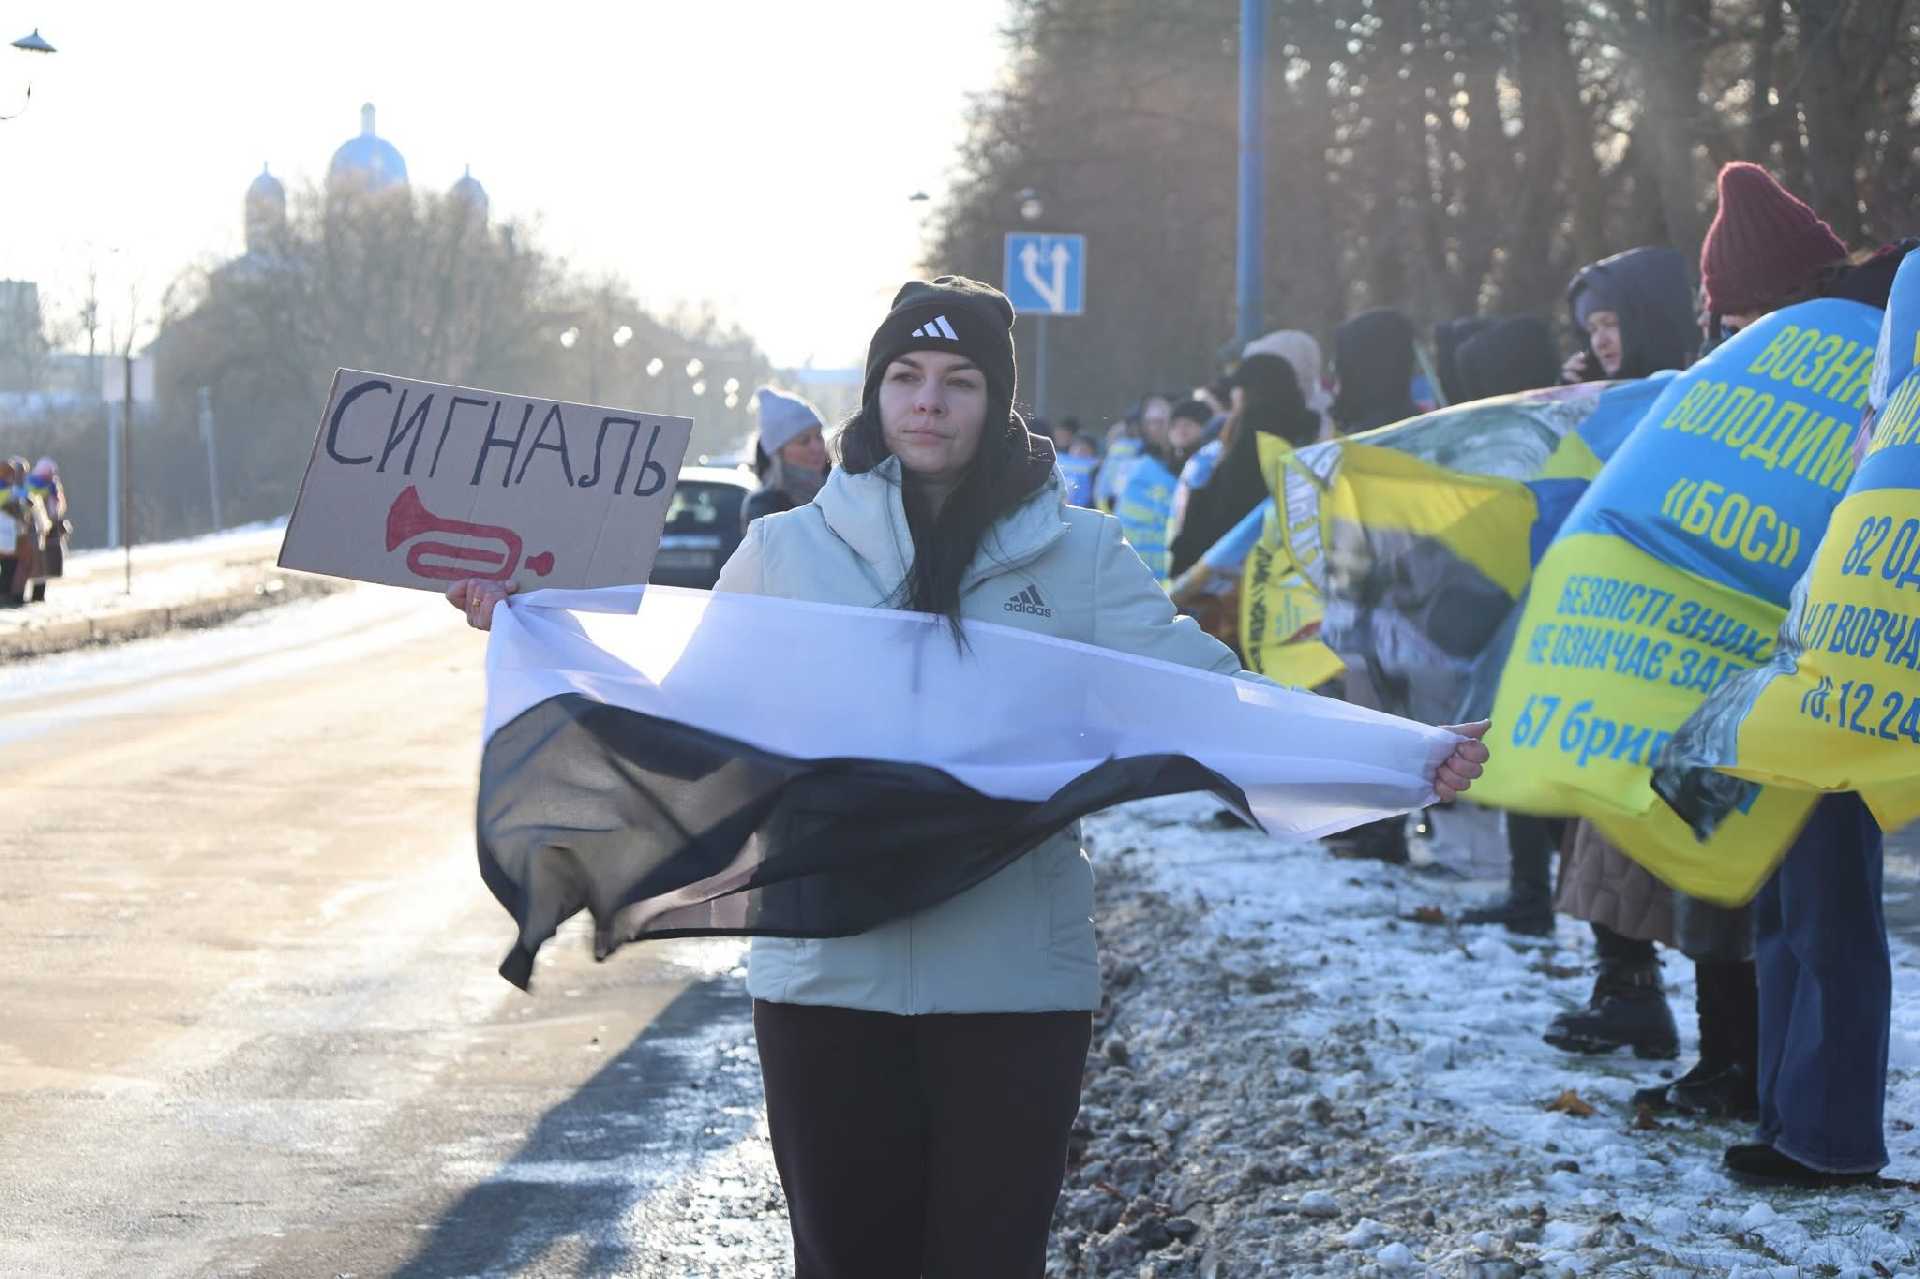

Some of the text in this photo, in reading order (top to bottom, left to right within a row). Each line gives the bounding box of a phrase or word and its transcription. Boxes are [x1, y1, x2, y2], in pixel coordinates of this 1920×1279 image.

[326, 380, 667, 497] СИГНАЛЬ
[1661, 478, 1801, 569] «БОС»
[1841, 516, 1892, 576] 82
[1003, 601, 1052, 618] adidas
[1828, 604, 1920, 672] ВОВЧА
[1512, 695, 1560, 748] 67
